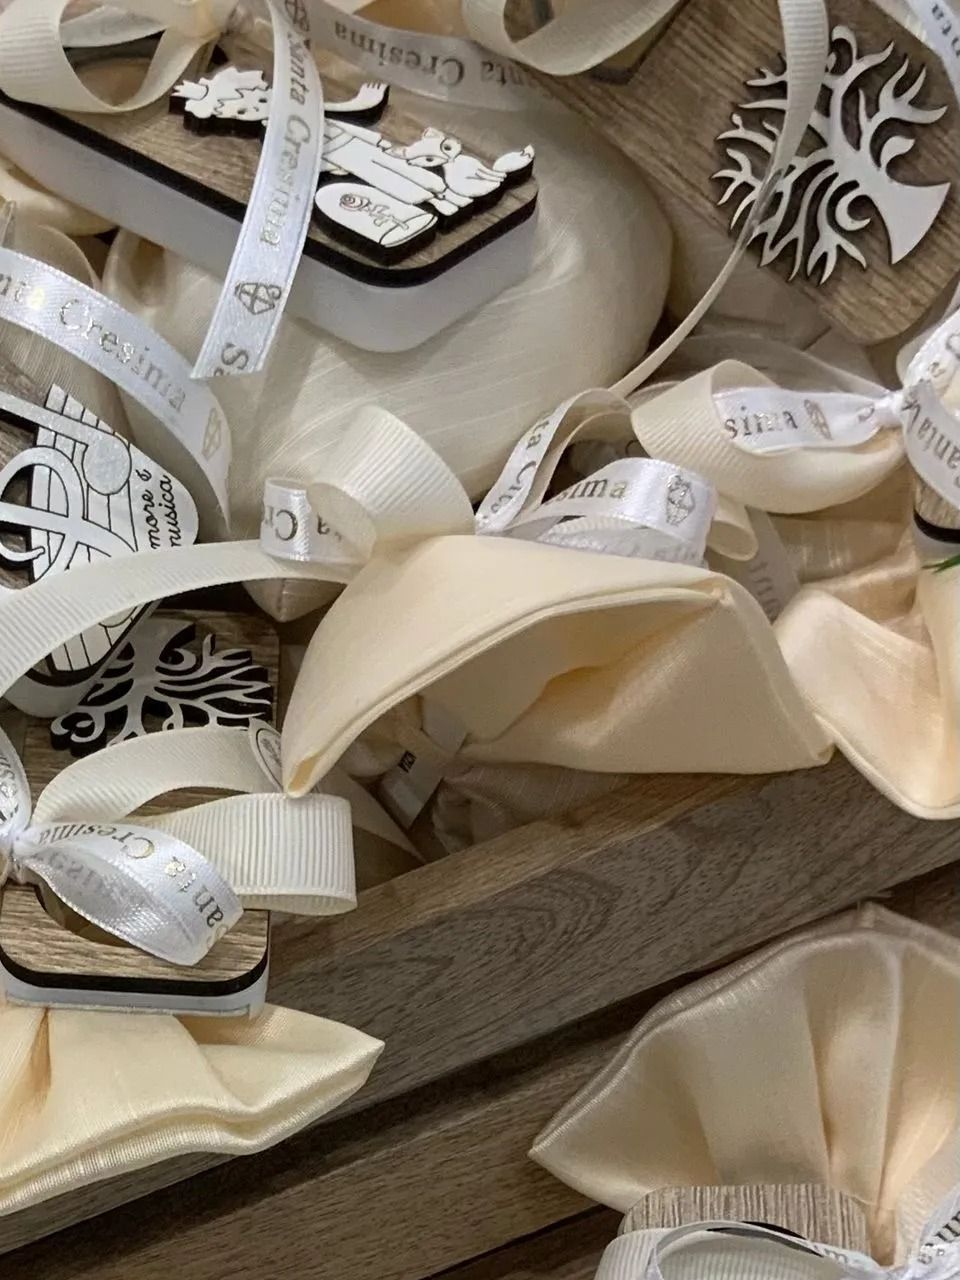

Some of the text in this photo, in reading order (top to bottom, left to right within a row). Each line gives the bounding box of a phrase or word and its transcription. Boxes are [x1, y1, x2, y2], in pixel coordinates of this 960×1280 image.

[334, 20, 465, 88] Cresima
[260, 114, 312, 247] Cresima
[58, 299, 187, 413] Cresima
[141, 489, 161, 550] more
